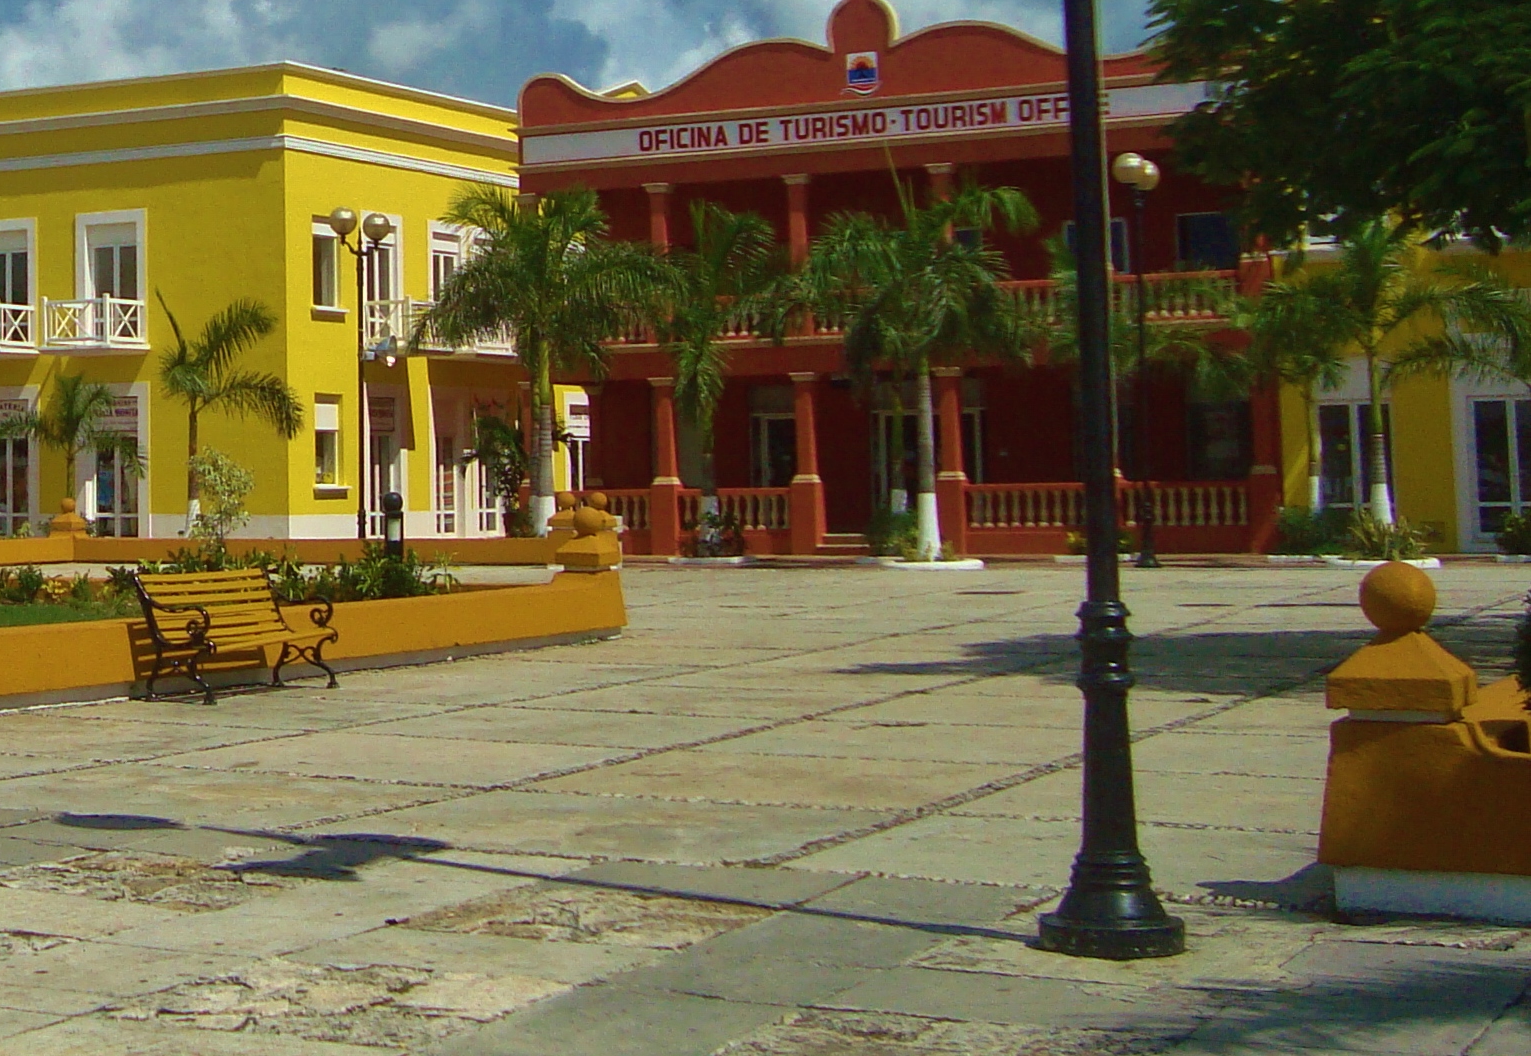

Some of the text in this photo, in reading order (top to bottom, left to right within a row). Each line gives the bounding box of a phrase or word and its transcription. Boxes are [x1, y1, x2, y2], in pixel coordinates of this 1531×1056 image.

[638, 124, 728, 152] OFICINA
[737, 120, 769, 144] DE
[779, 111, 887, 142] TURISMO
[900, 101, 1008, 132] TOURISM
